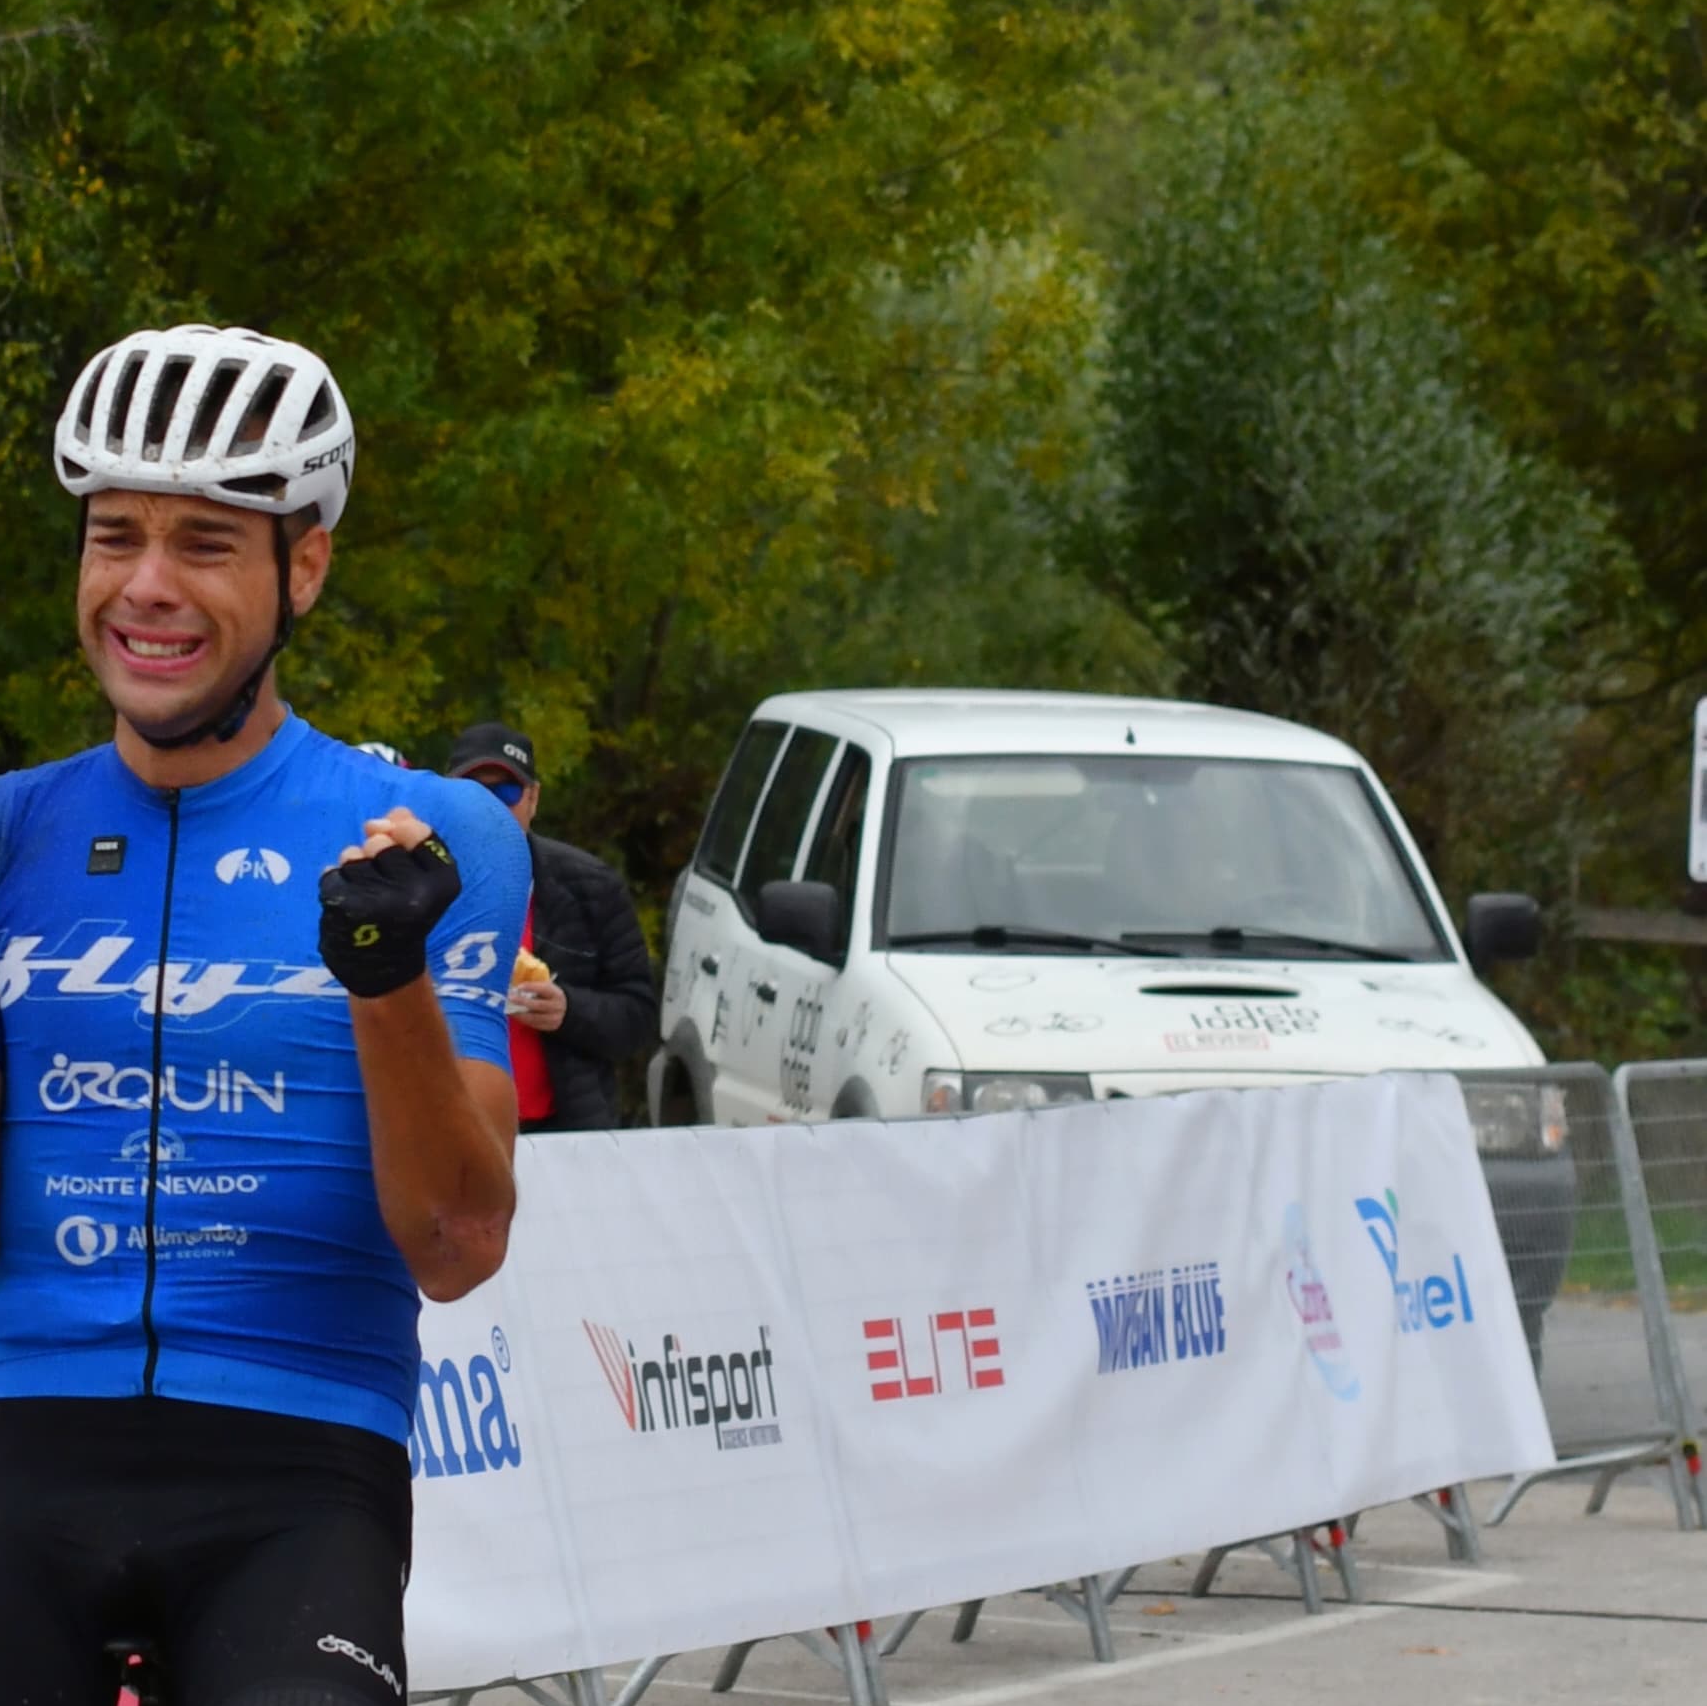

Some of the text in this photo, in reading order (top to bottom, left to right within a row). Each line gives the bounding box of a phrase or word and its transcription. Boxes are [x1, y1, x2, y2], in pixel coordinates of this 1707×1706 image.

[238, 860, 269, 879] PK
[46, 1175, 135, 1196] MONTE
[862, 1307, 1006, 1401] ELITE
